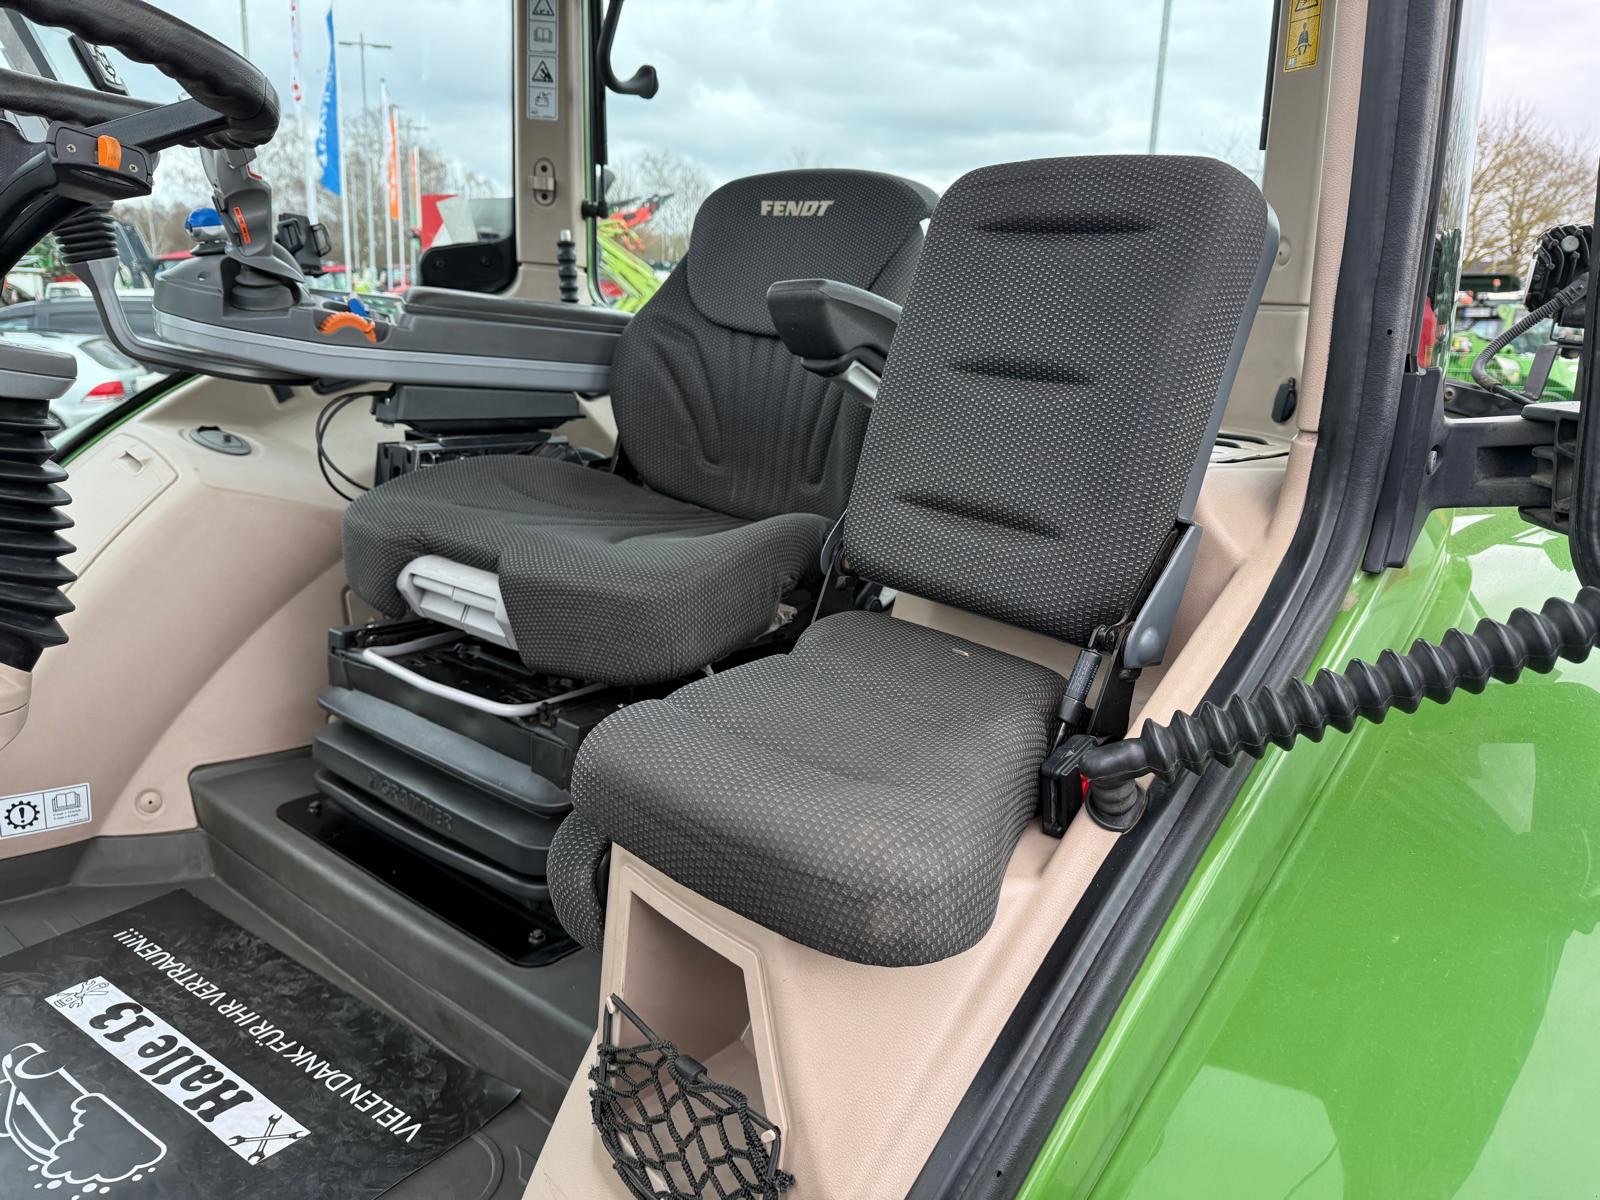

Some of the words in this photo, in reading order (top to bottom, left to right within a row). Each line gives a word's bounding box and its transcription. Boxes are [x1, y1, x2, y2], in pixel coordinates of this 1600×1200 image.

[760, 199, 835, 217] FENDT
[113, 928, 227, 1006] VERTRAUEN!!!
[89, 1002, 155, 1043] 13
[217, 998, 260, 1027] IHR
[248, 1019, 297, 1053] FÜR
[137, 1034, 254, 1123] Halle
[283, 1045, 354, 1092] DANK
[340, 1082, 422, 1143] VIELEN
